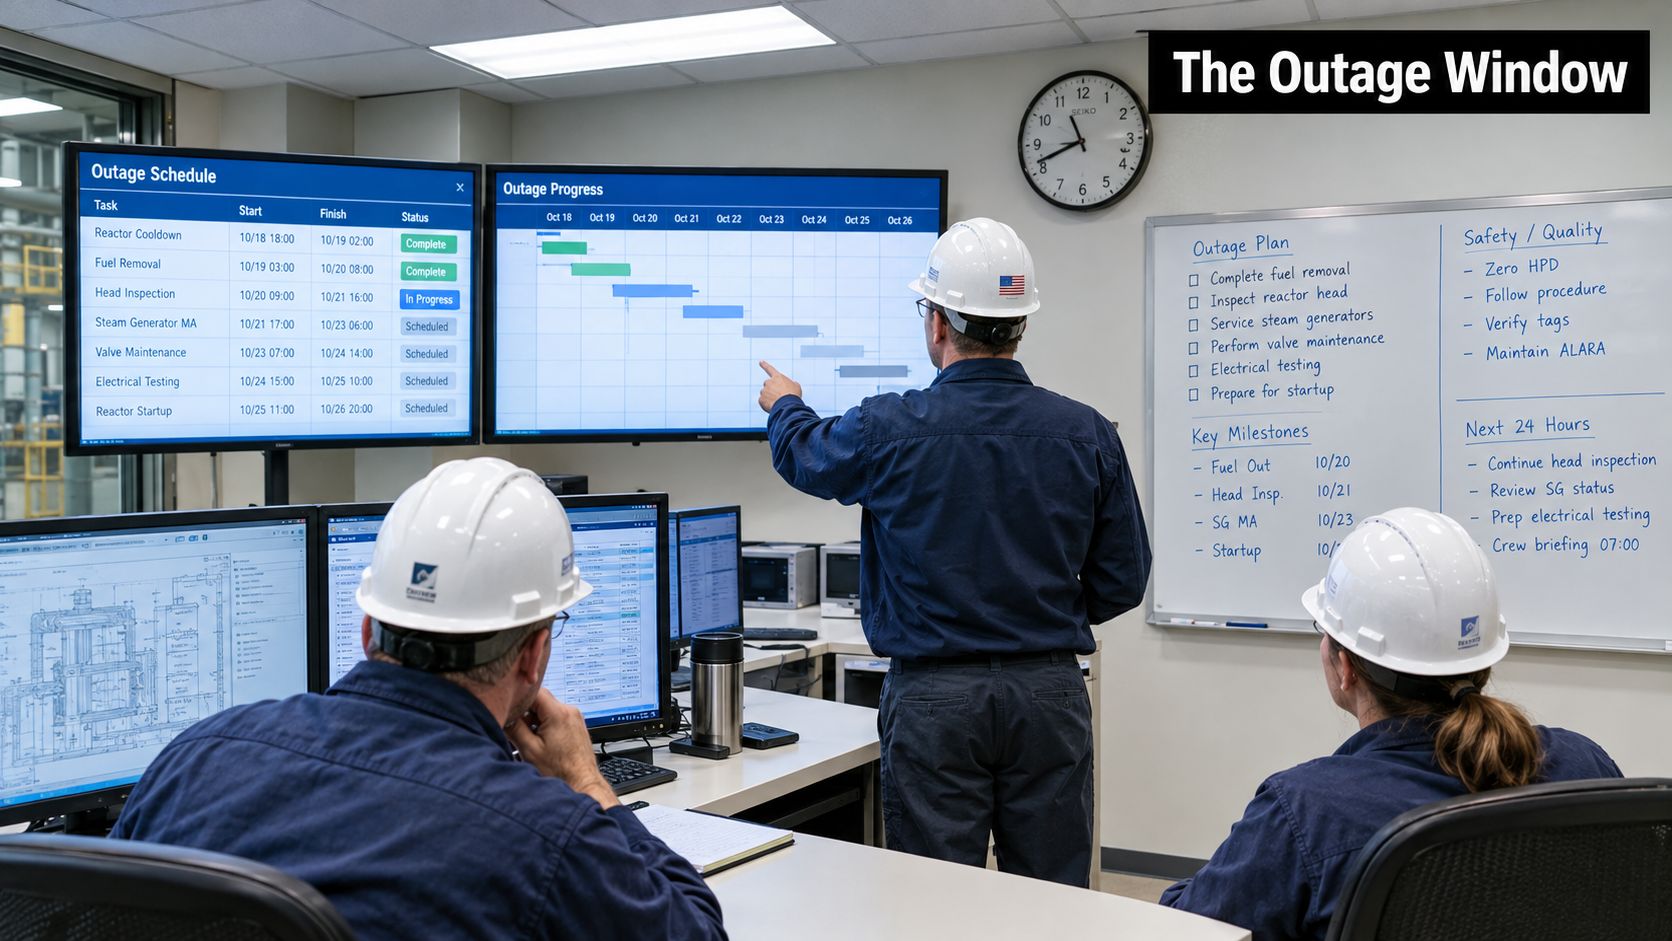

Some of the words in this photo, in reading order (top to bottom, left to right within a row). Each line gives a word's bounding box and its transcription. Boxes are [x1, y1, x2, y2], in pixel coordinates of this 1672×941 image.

[1077, 87, 1090, 99] 12
[1105, 92, 1109, 103] 1
[1056, 96, 1065, 107] 11
[1039, 114, 1051, 126] 10
[1120, 108, 1127, 120] 2
[1034, 139, 1041, 150] 9
[1127, 133, 1134, 144] 3
[1039, 161, 1047, 174] 8
[1119, 158, 1127, 169] 4
[91, 164, 146, 184] Outage
[150, 166, 217, 184] Schedule
[1056, 178, 1064, 190] 7
[1103, 176, 1110, 188] 5
[503, 181, 547, 198] Outage
[550, 182, 603, 199] Progress
[1079, 184, 1086, 196] 6
[95, 199, 118, 211] Task
[239, 205, 262, 217] Start
[320, 208, 347, 220] Finish
[402, 212, 429, 223] Status
[546, 212, 561, 223] Oct
[562, 212, 572, 223] 18
[589, 212, 604, 223] Oct
[605, 212, 615, 223] 19
[632, 213, 647, 223] Oct
[648, 213, 658, 223] 20
[674, 213, 688, 224] Oct
[690, 213, 699, 224] 21
[716, 214, 731, 224] Oct
[732, 214, 742, 224] 22
[759, 214, 774, 224] Oct
[775, 214, 784, 224] 23
[801, 214, 816, 225] Oct
[817, 214, 827, 225] 24
[844, 215, 860, 225] Oct
[861, 215, 870, 225] 25
[887, 215, 902, 226] Oct
[903, 215, 913, 226] 26
[95, 227, 132, 241] Reactor
[135, 227, 182, 241] Cooldown
[240, 231, 266, 245] 10/18
[269, 232, 295, 245] 18:00
[321, 234, 346, 247] 10/19
[349, 234, 374, 247] 02:00
[1464, 227, 1517, 251] Safety
[1527, 224, 1535, 243] /
[1542, 221, 1602, 245] Quality
[405, 238, 447, 251] Complete
[1193, 238, 1247, 260] Outage
[1256, 235, 1289, 251] Plan
[95, 257, 115, 269] Fuel
[118, 258, 161, 269] Removal
[240, 260, 266, 273] 10/19
[269, 261, 295, 273] 03:00
[321, 262, 346, 275] 10/20
[349, 263, 374, 275] 08:00
[1485, 262, 1518, 276] Zero
[1529, 258, 1559, 272] HPD
[405, 265, 446, 278] Complete
[1210, 269, 1264, 288] Complete
[1271, 266, 1295, 281] fuel
[1302, 261, 1351, 278] removal
[95, 287, 121, 299] Head
[124, 287, 176, 301] Inspection
[240, 288, 266, 302] 10/20
[269, 289, 295, 302] 09:00
[321, 290, 346, 304] 10/21
[349, 291, 374, 304] 16:00
[1210, 293, 1255, 311] Inspect
[1264, 290, 1309, 303] reactor
[1317, 284, 1348, 299] head
[1486, 287, 1528, 303] Follow
[1538, 281, 1607, 305] procedure
[405, 294, 413, 304] In
[415, 294, 453, 306] Progress
[95, 316, 127, 329] Steam
[130, 317, 178, 329] Generator
[181, 317, 197, 328] MA
[240, 317, 266, 330] 10/21
[269, 318, 295, 330] 17:00
[321, 318, 346, 332] 10/23
[349, 319, 374, 332] 06:00
[405, 321, 449, 333] Scheduled
[1210, 317, 1254, 331] Service
[1262, 315, 1299, 326] steam
[1306, 310, 1374, 330] generators
[1486, 314, 1527, 335] Verify
[1537, 313, 1570, 333] tags
[1211, 339, 1259, 354] Perform
[1267, 336, 1299, 349] valve
[1306, 333, 1385, 347] maintenance
[95, 347, 122, 358] Valve
[125, 347, 187, 358] Maintenance
[240, 346, 266, 359] 10/23
[269, 346, 295, 359] 07:00
[321, 346, 346, 360] 10/24
[349, 347, 374, 360] 14:00
[405, 348, 449, 360] Scheduled
[1486, 345, 1549, 360] Maintain
[1560, 341, 1606, 358] ALARA
[1211, 360, 1270, 376] Electrical
[1278, 358, 1321, 376] testing
[95, 376, 142, 388] Electrical
[145, 376, 180, 389] Testing
[240, 374, 266, 388] 10/24
[269, 375, 295, 388] 15:00
[321, 374, 346, 388] 10/25
[349, 375, 374, 388] 10:00
[405, 376, 448, 387] Scheduled
[1211, 387, 1255, 404] Prepare
[1262, 384, 1280, 397] for
[1287, 382, 1335, 400] startup
[95, 405, 133, 417] Reactor
[136, 405, 172, 419] Startup
[240, 403, 266, 416] 10/25
[269, 403, 295, 416] 11:00
[321, 402, 346, 416] 10/26
[349, 403, 374, 416] 20:00
[405, 403, 448, 414] Scheduled
[1466, 420, 1504, 438] Next
[1515, 419, 1534, 434] 24
[1546, 416, 1590, 432] Hours
[1192, 428, 1218, 450] Key
[1228, 424, 1309, 442] Milestones
[1212, 459, 1237, 475] Fuel
[1247, 459, 1271, 473] Out
[1315, 455, 1351, 471] 10/20
[1488, 455, 1543, 471] Continue
[1551, 453, 1582, 468] head
[1592, 452, 1656, 472] inspection
[1212, 487, 1243, 502] Head
[1251, 486, 1284, 506] Insp.
[1317, 484, 1351, 499] 10/21
[1490, 483, 1536, 498] Review
[1546, 482, 1564, 496] SG
[1573, 480, 1614, 494] status
[1213, 515, 1229, 529] SG
[1238, 515, 1258, 528] MA
[1318, 513, 1354, 528] 10/23
[1492, 510, 1522, 528] Prep
[1531, 507, 1594, 523] electrical
[1602, 506, 1650, 528] testing
[1213, 543, 1262, 562] Startup
[1317, 540, 1340, 556] 10/
[1493, 538, 1526, 553] Crew
[1535, 536, 1588, 558] briefing
[1600, 538, 1640, 551] 07:00
